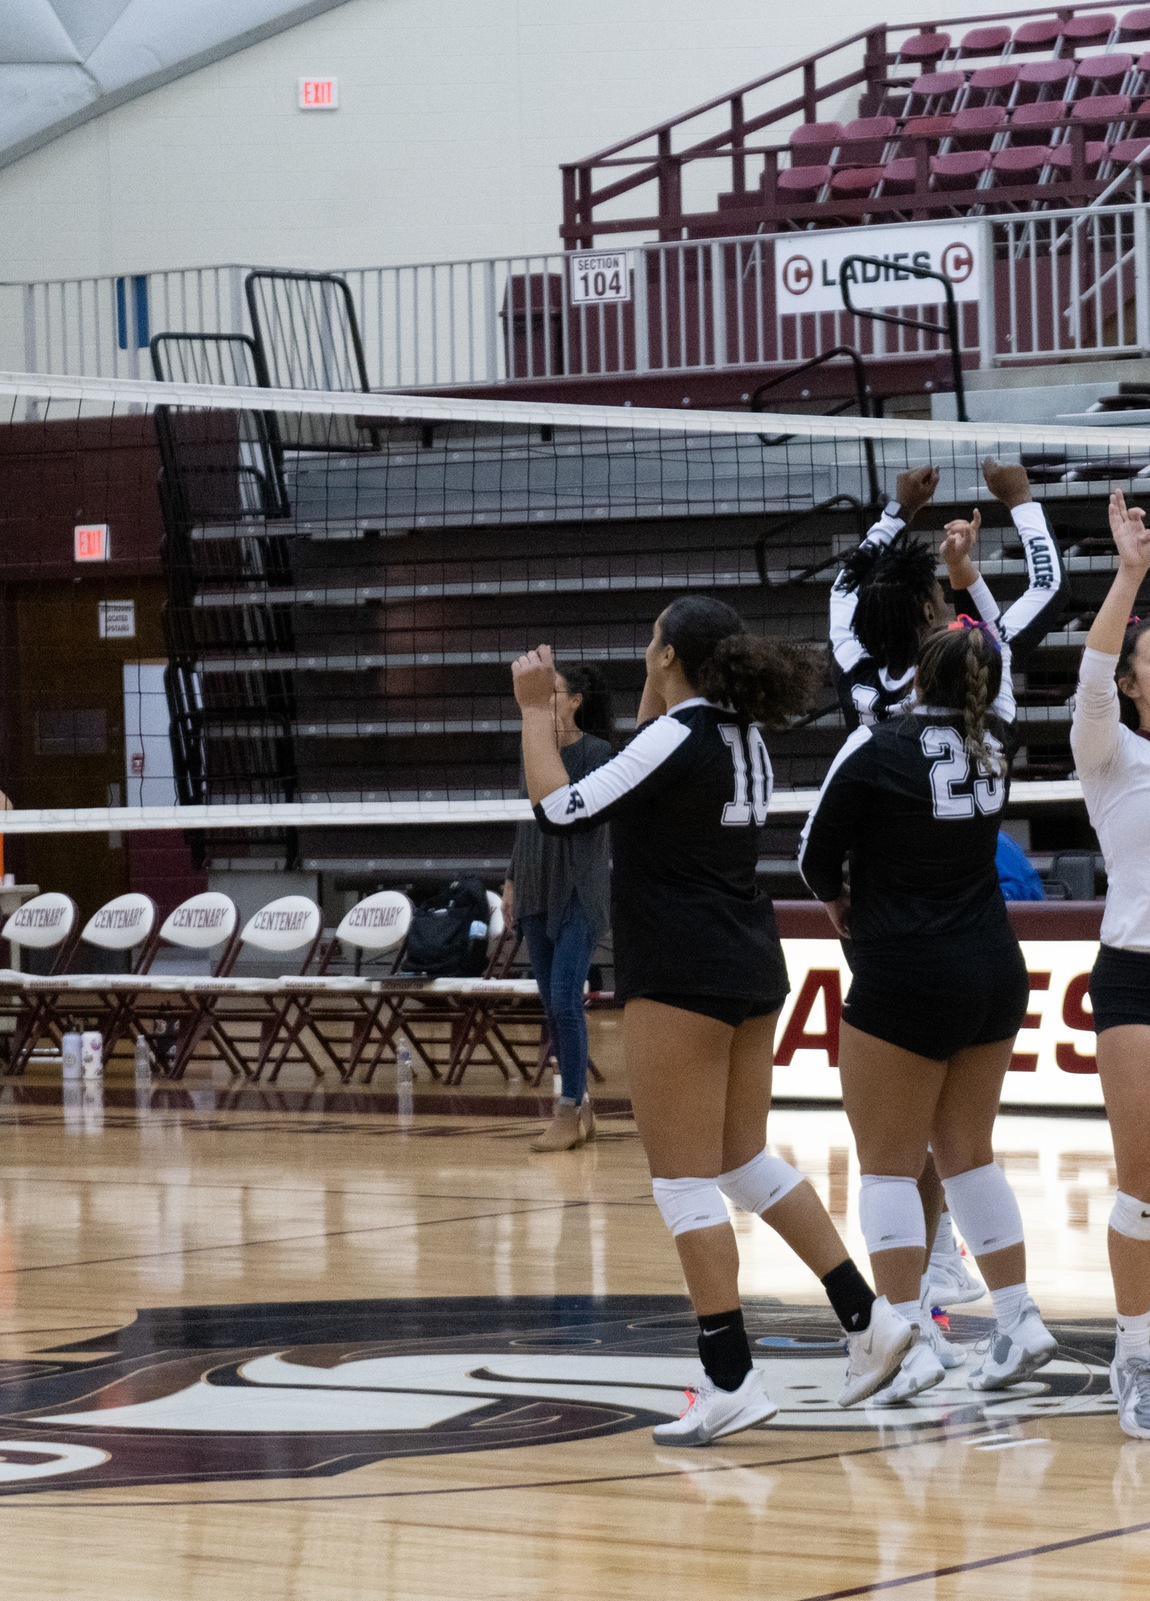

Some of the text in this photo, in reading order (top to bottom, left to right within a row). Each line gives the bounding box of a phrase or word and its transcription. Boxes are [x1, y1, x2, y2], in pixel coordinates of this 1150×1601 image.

[304, 81, 333, 104] EXIT
[577, 257, 620, 271] SECTION
[821, 251, 931, 287] LADIES
[580, 270, 622, 297] 104
[79, 530, 103, 557] EXIT
[1028, 535, 1054, 589] LADIES
[717, 723, 774, 826] 10
[14, 906, 68, 928] CENTENARY
[94, 906, 147, 929] CENTENARY
[172, 907, 229, 929] CENTENARY
[253, 910, 312, 931] CENTENARY
[349, 906, 404, 927] CENTENARY
